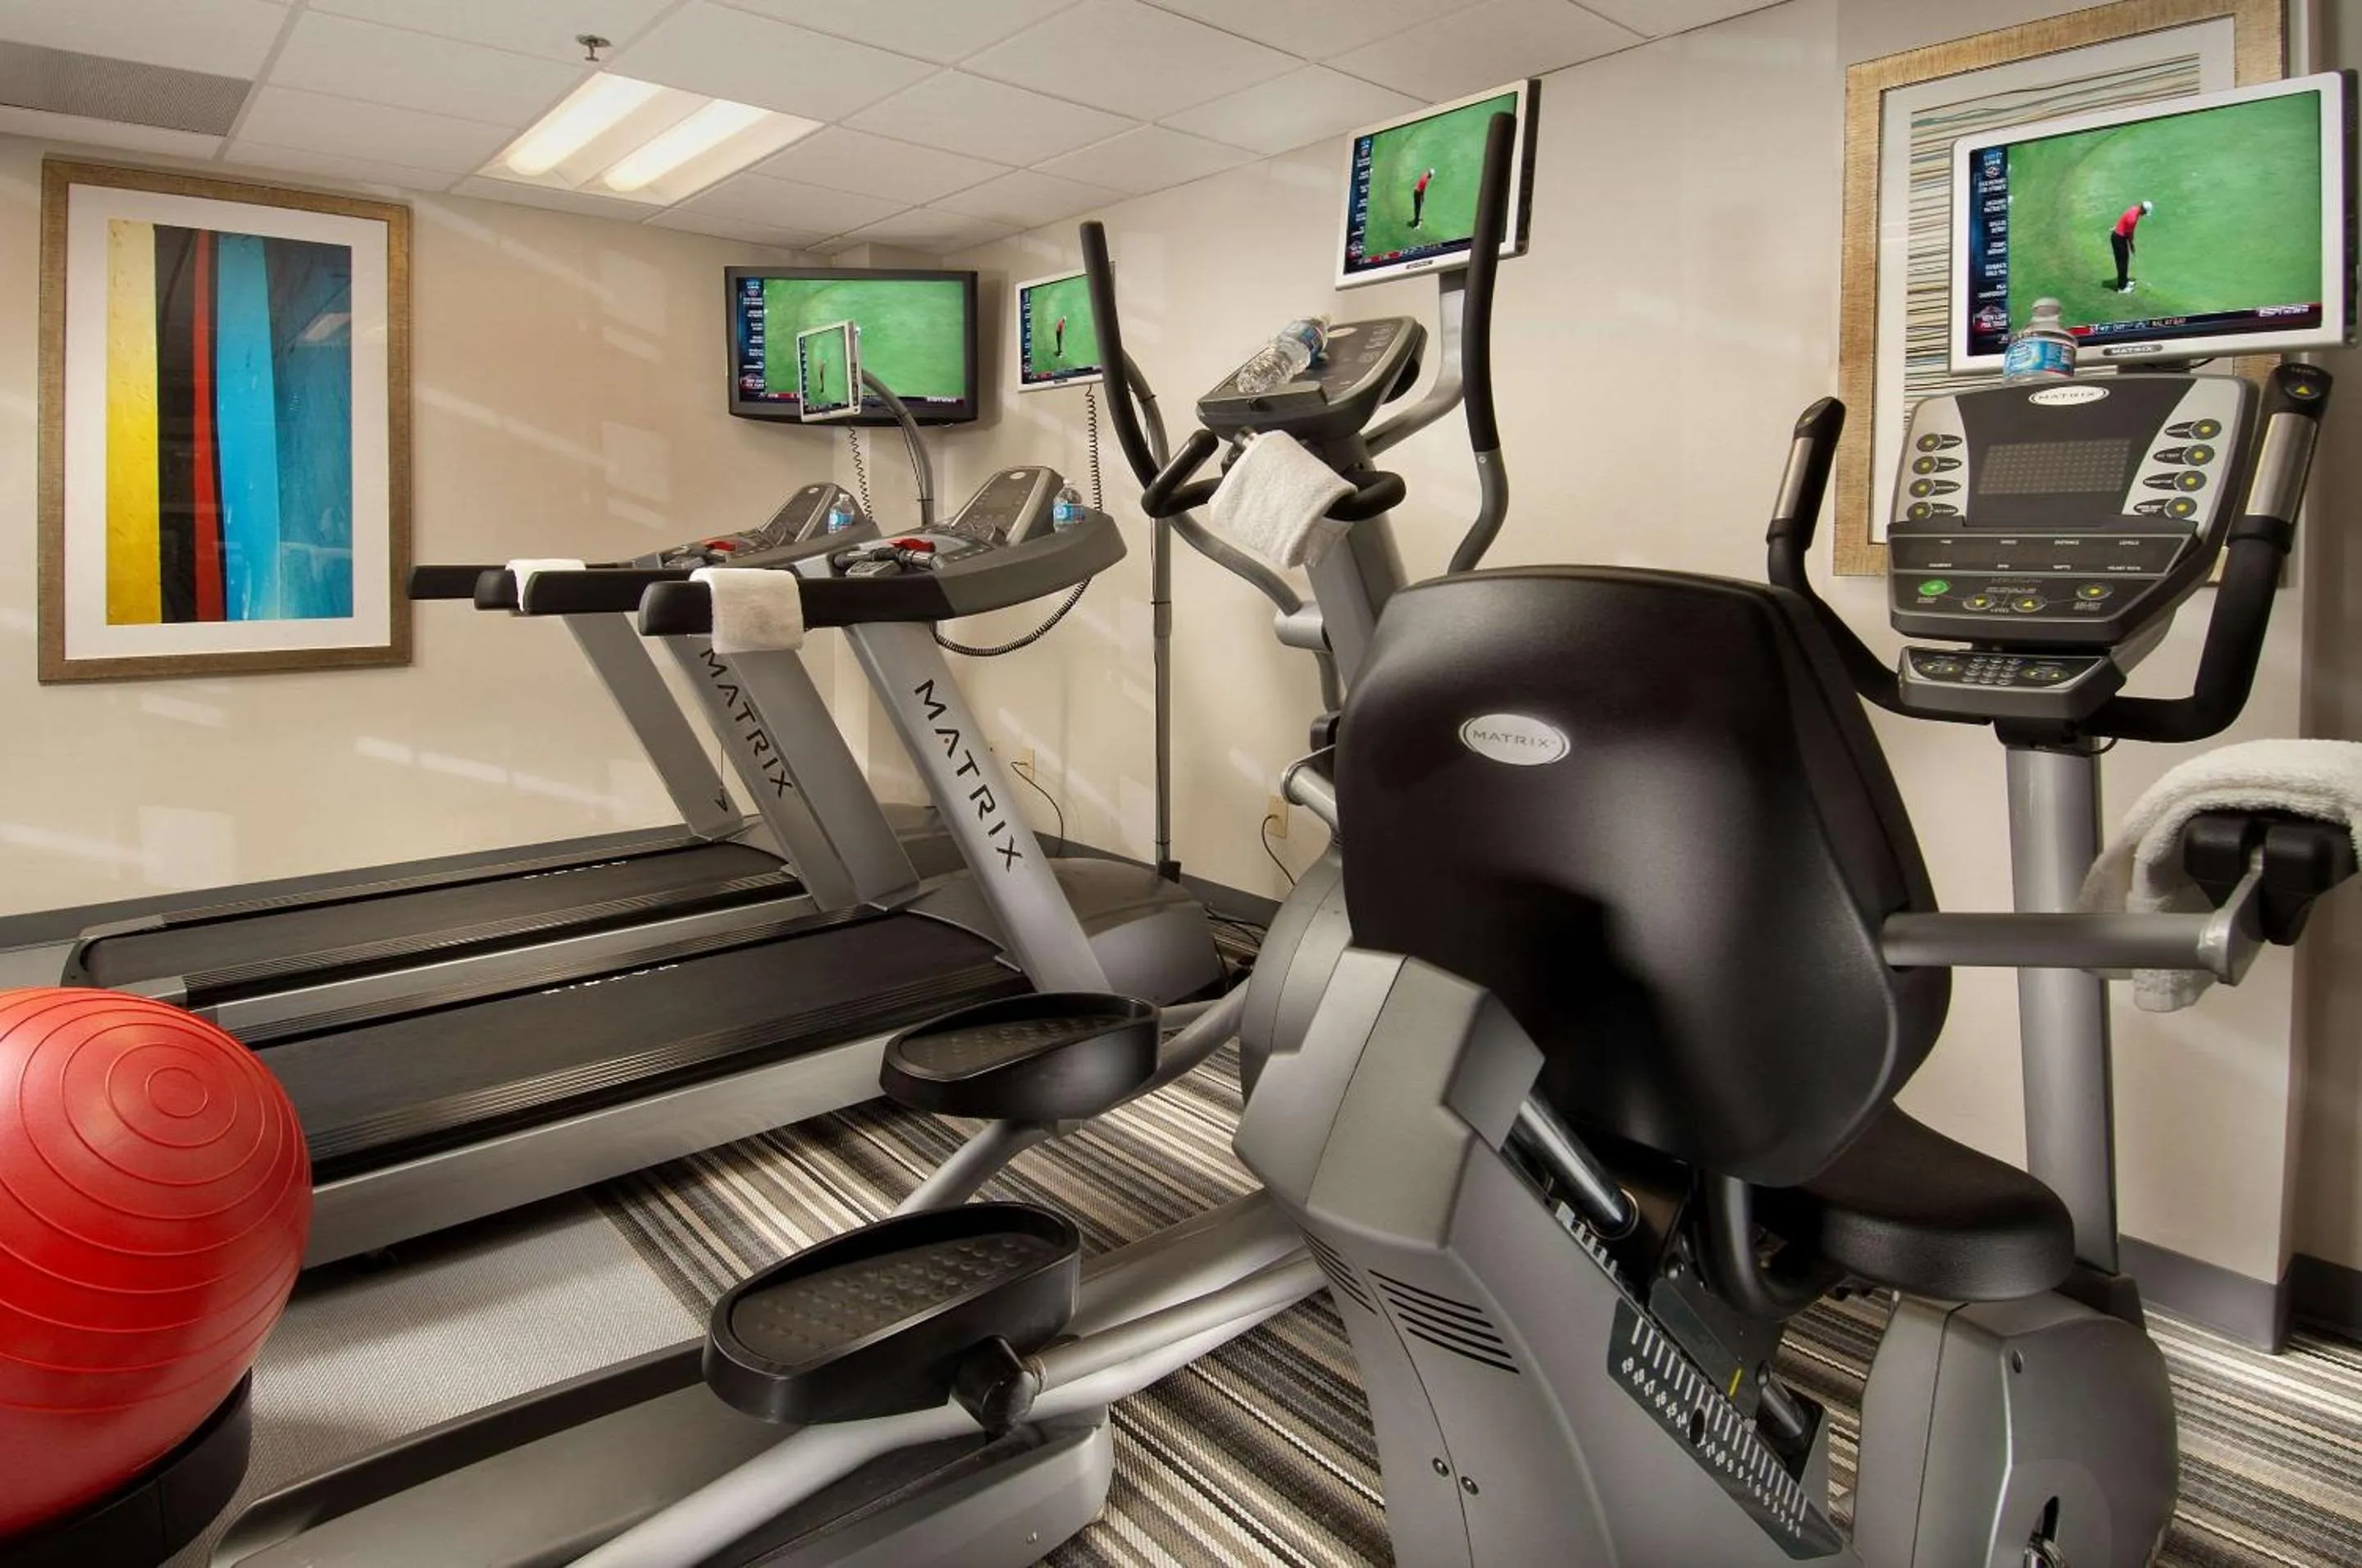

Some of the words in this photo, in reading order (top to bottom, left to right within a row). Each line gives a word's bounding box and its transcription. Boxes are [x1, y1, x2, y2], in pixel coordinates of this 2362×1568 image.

[2038, 392, 2095, 400] MATRIX
[700, 648, 793, 799] MATRIX
[1473, 729, 1549, 748] MATRIX
[914, 679, 1023, 873] MATRIX
[1644, 1379, 1656, 1397] 17
[1655, 1391, 1667, 1408] 16
[1666, 1402, 1678, 1419] 15
[1676, 1411, 1688, 1428] 14
